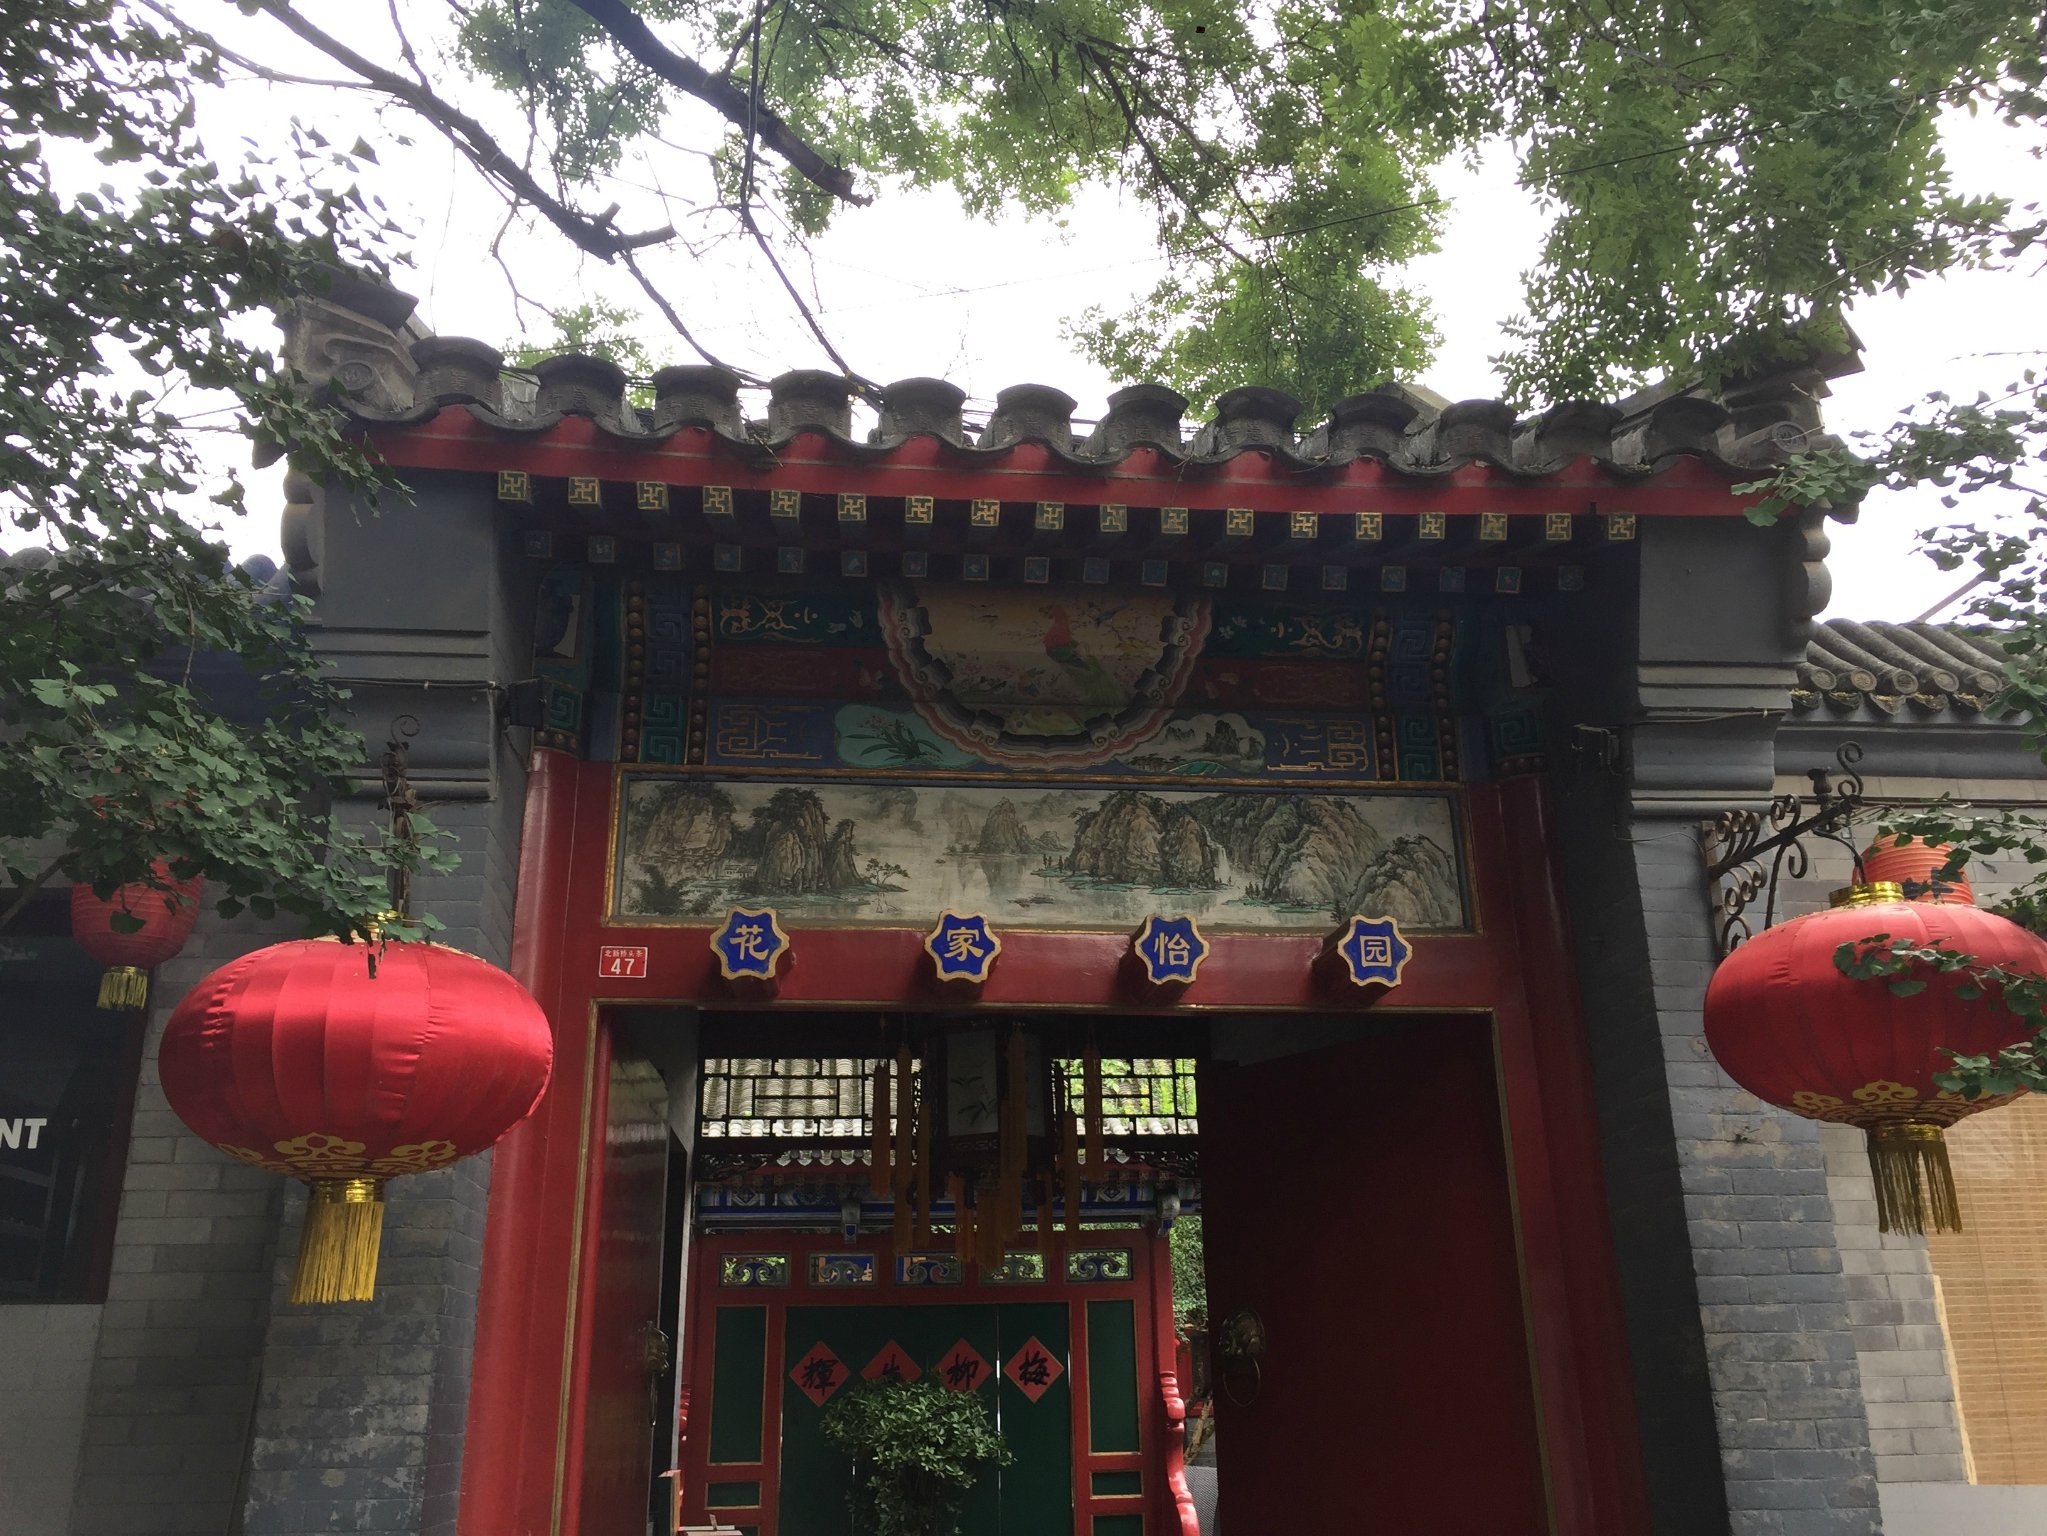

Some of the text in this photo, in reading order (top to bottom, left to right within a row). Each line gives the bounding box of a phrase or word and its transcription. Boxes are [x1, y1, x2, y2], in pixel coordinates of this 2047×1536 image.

[730, 924, 1392, 967] 花 家 怡 园
[610, 958, 635, 975] 47
[0, 1118, 48, 1149] NT
